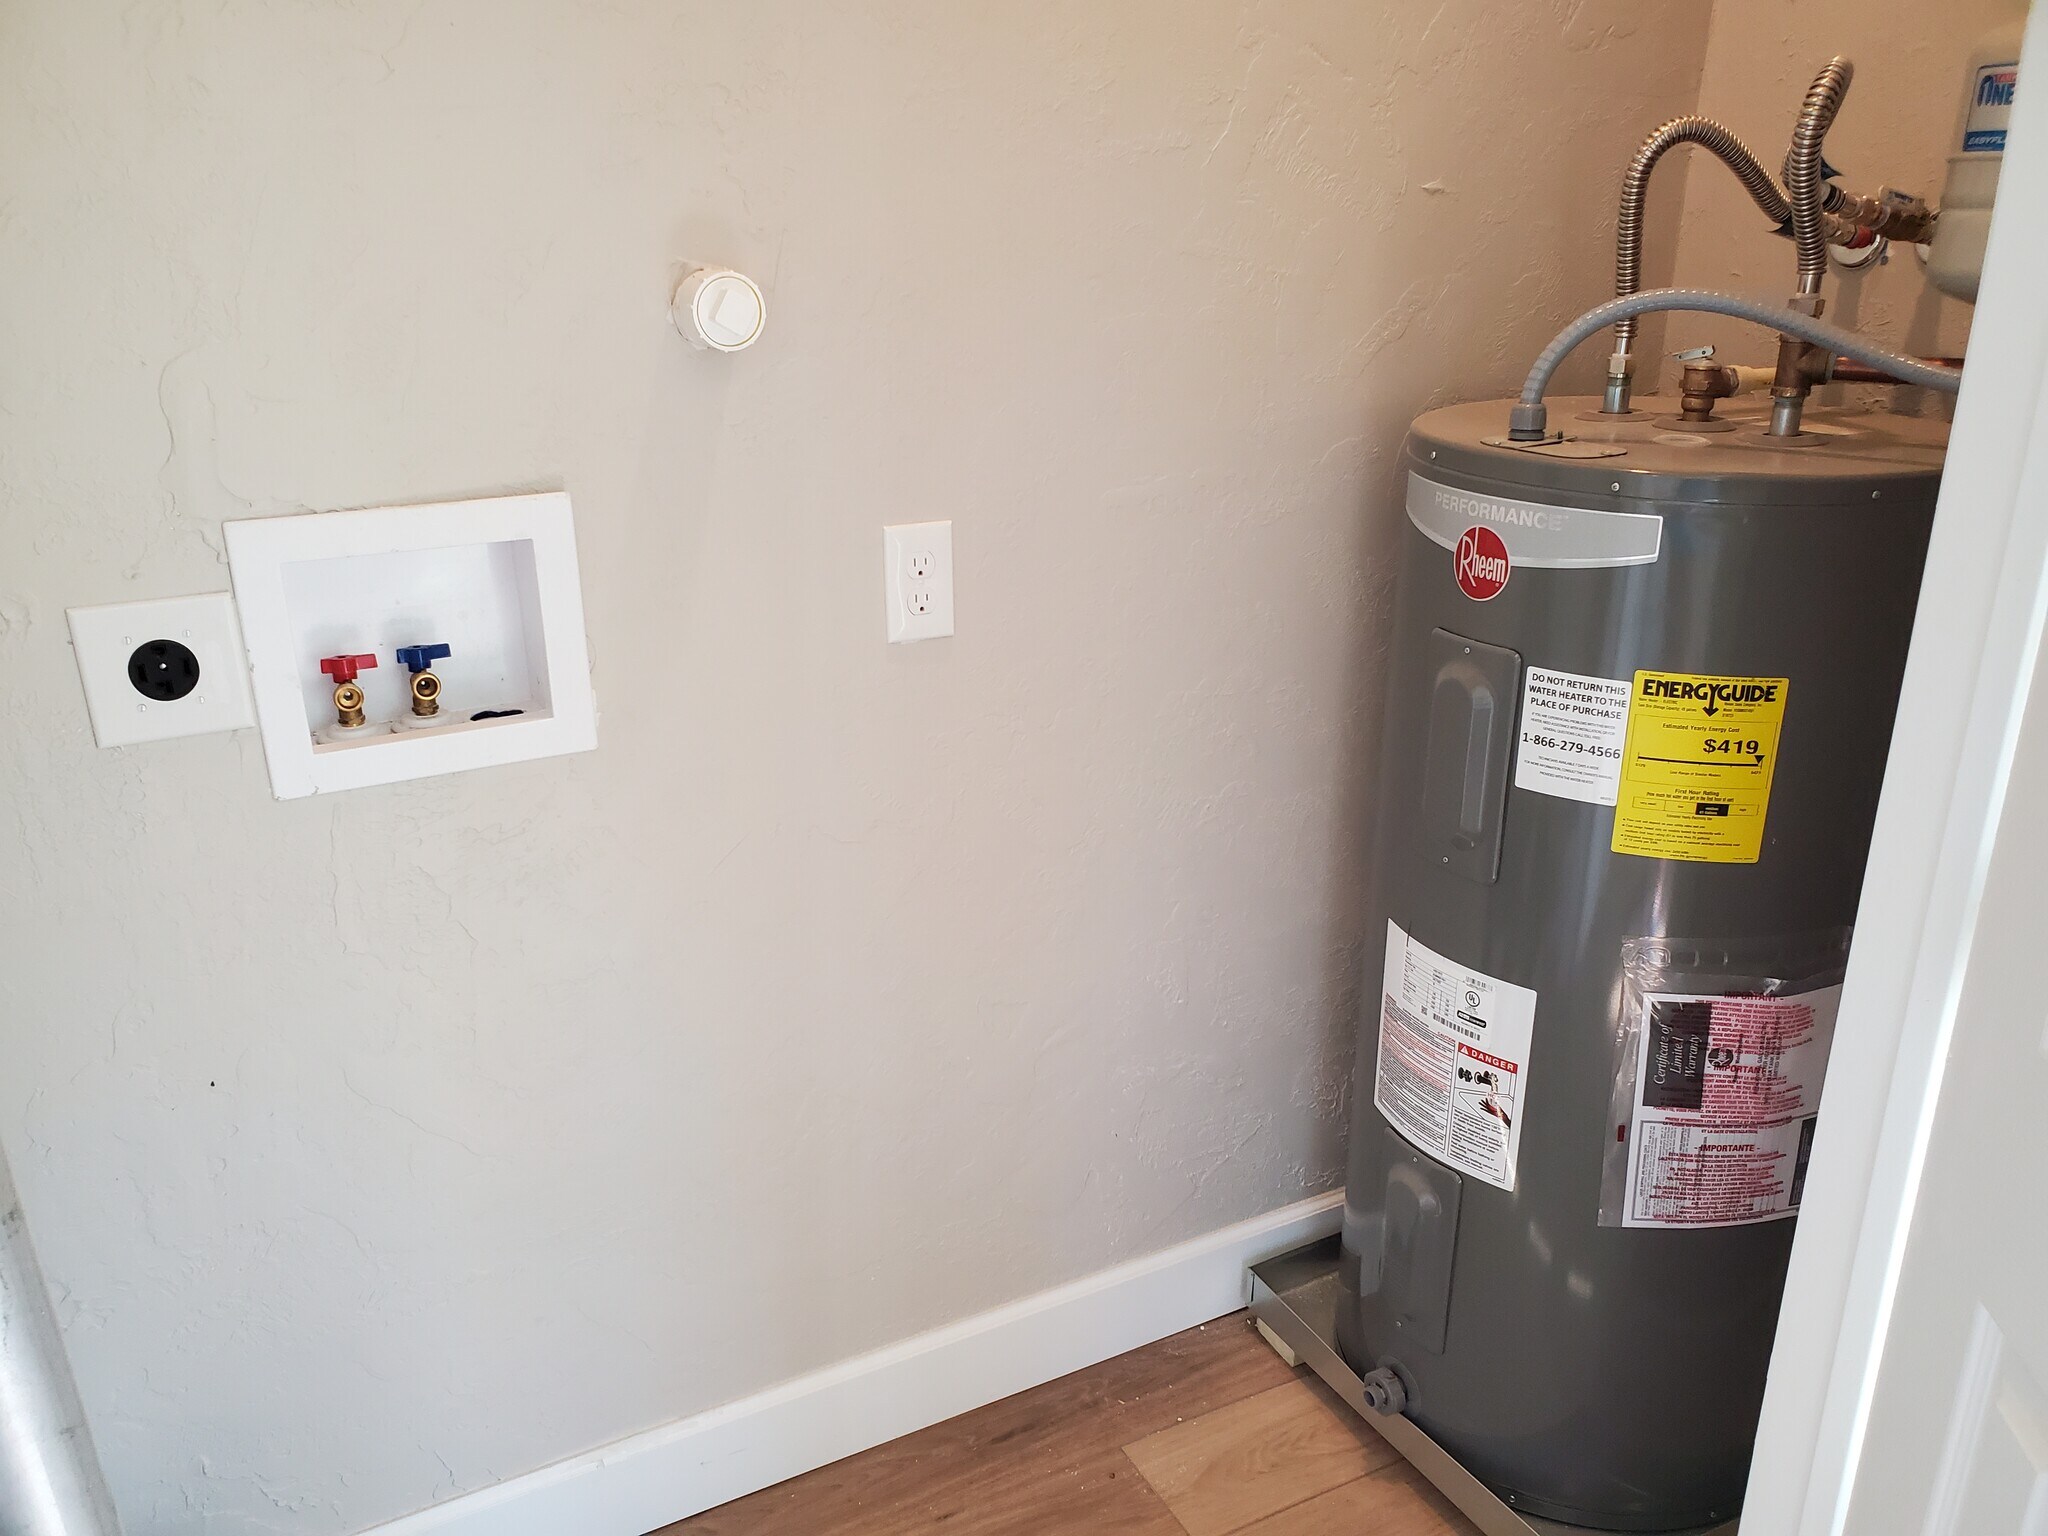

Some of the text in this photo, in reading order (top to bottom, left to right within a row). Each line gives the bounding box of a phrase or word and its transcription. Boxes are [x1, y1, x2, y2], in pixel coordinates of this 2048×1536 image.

[1434, 491, 1563, 531] PERFORMANCE
[1459, 526, 1506, 587] Rheem
[1528, 684, 1556, 697] WATER
[1558, 690, 1592, 704] HEATER
[1594, 696, 1606, 706] TO
[1608, 698, 1627, 708] THE
[1532, 673, 1626, 696] DO NOT RETURN THIS
[1642, 679, 1778, 702] ENERGYGUIDE
[1530, 696, 1556, 710] PLACE
[1558, 702, 1570, 712] OF
[1572, 705, 1622, 720] PURCHASE
[1522, 732, 1620, 760] 1-866-279-4566
[1702, 738, 1759, 754] $419
[1472, 1050, 1514, 1071] DANGER
[1654, 1022, 1673, 1084] Certificate of
[1684, 1034, 1702, 1078] Warranty
